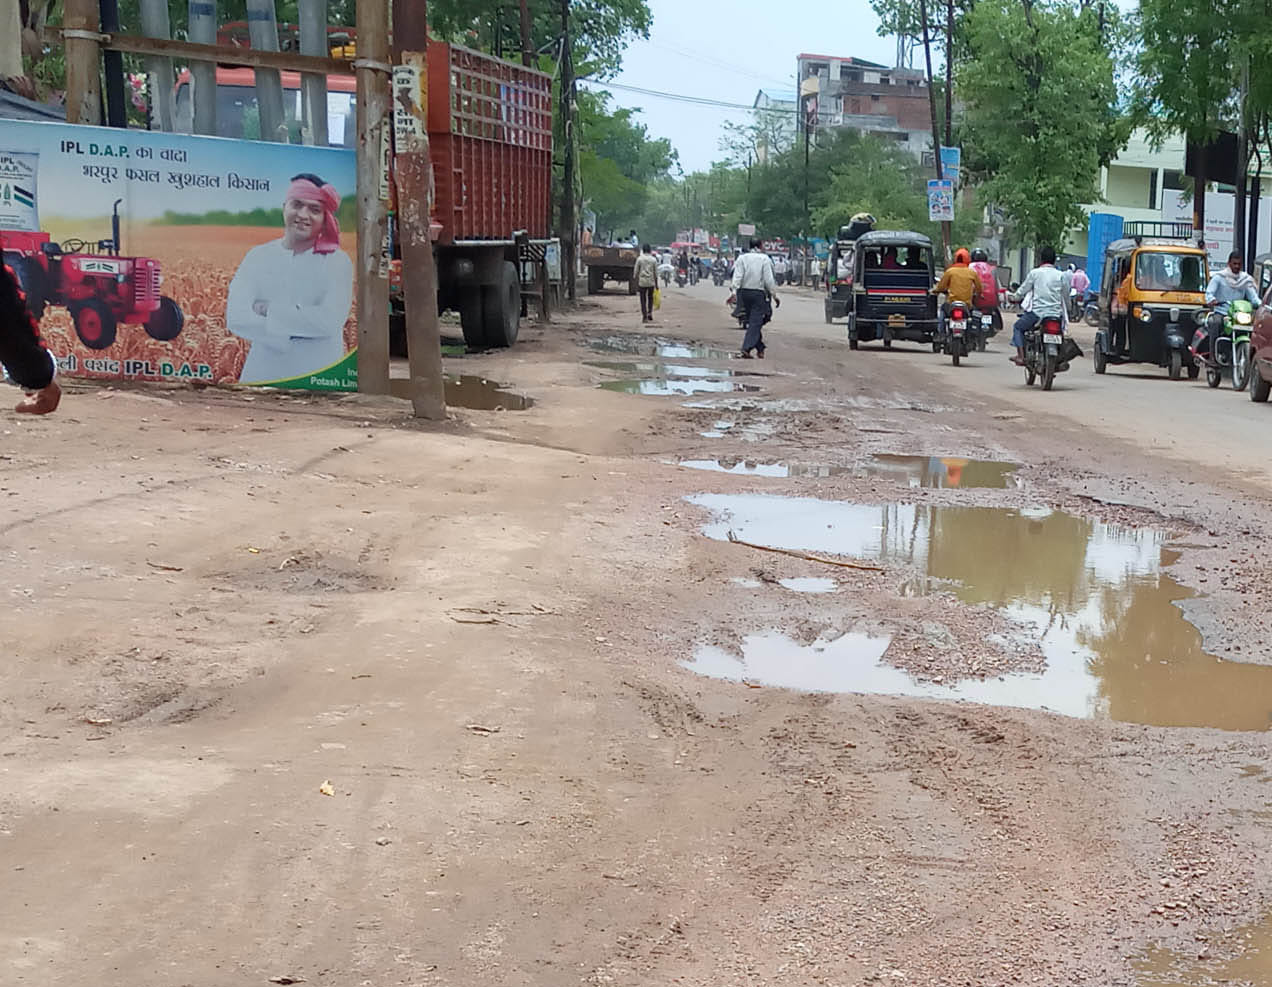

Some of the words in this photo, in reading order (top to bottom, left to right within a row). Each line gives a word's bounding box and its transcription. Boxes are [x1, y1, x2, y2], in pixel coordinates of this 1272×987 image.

[61, 140, 85, 155] IPL
[89, 143, 130, 159] D.A.P.
[160, 149, 188, 163] वादा
[82, 165, 119, 184] भरपूर
[125, 168, 160, 183] फसल
[168, 171, 220, 190] खुशहाल
[227, 172, 271, 192] किसान
[126, 360, 156, 376] IPL
[160, 362, 213, 379] D.A.P.
